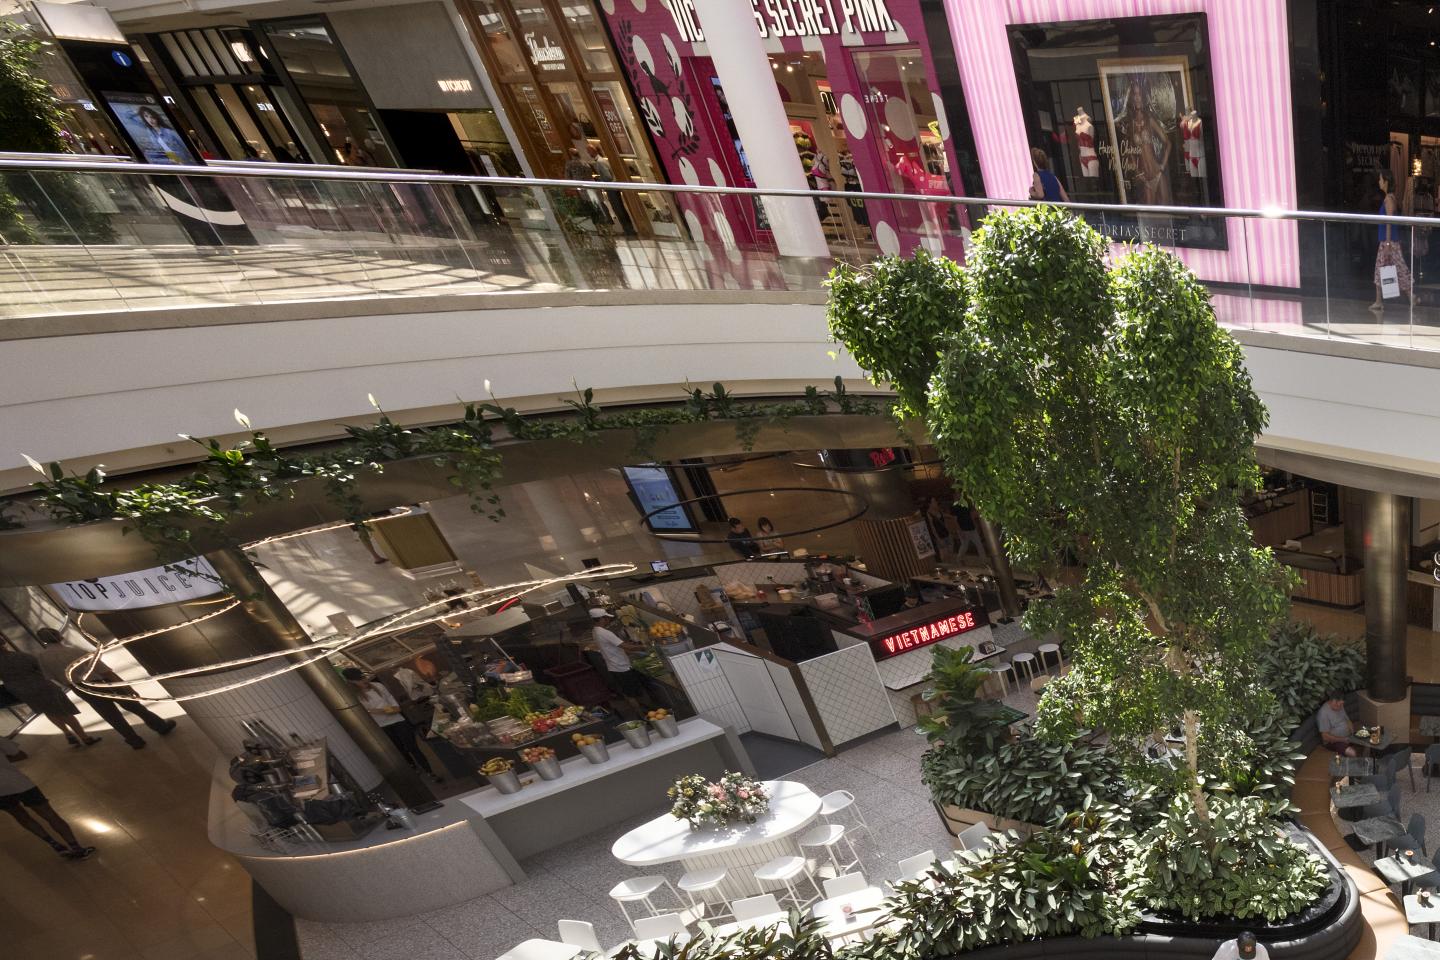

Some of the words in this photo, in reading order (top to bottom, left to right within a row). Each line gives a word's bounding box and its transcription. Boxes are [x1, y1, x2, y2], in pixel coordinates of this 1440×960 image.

[764, 0, 839, 37] SECRET
[841, 0, 896, 33] PINK
[1144, 225, 1187, 241] SECRET
[884, 611, 976, 653] VIETNAMESE
